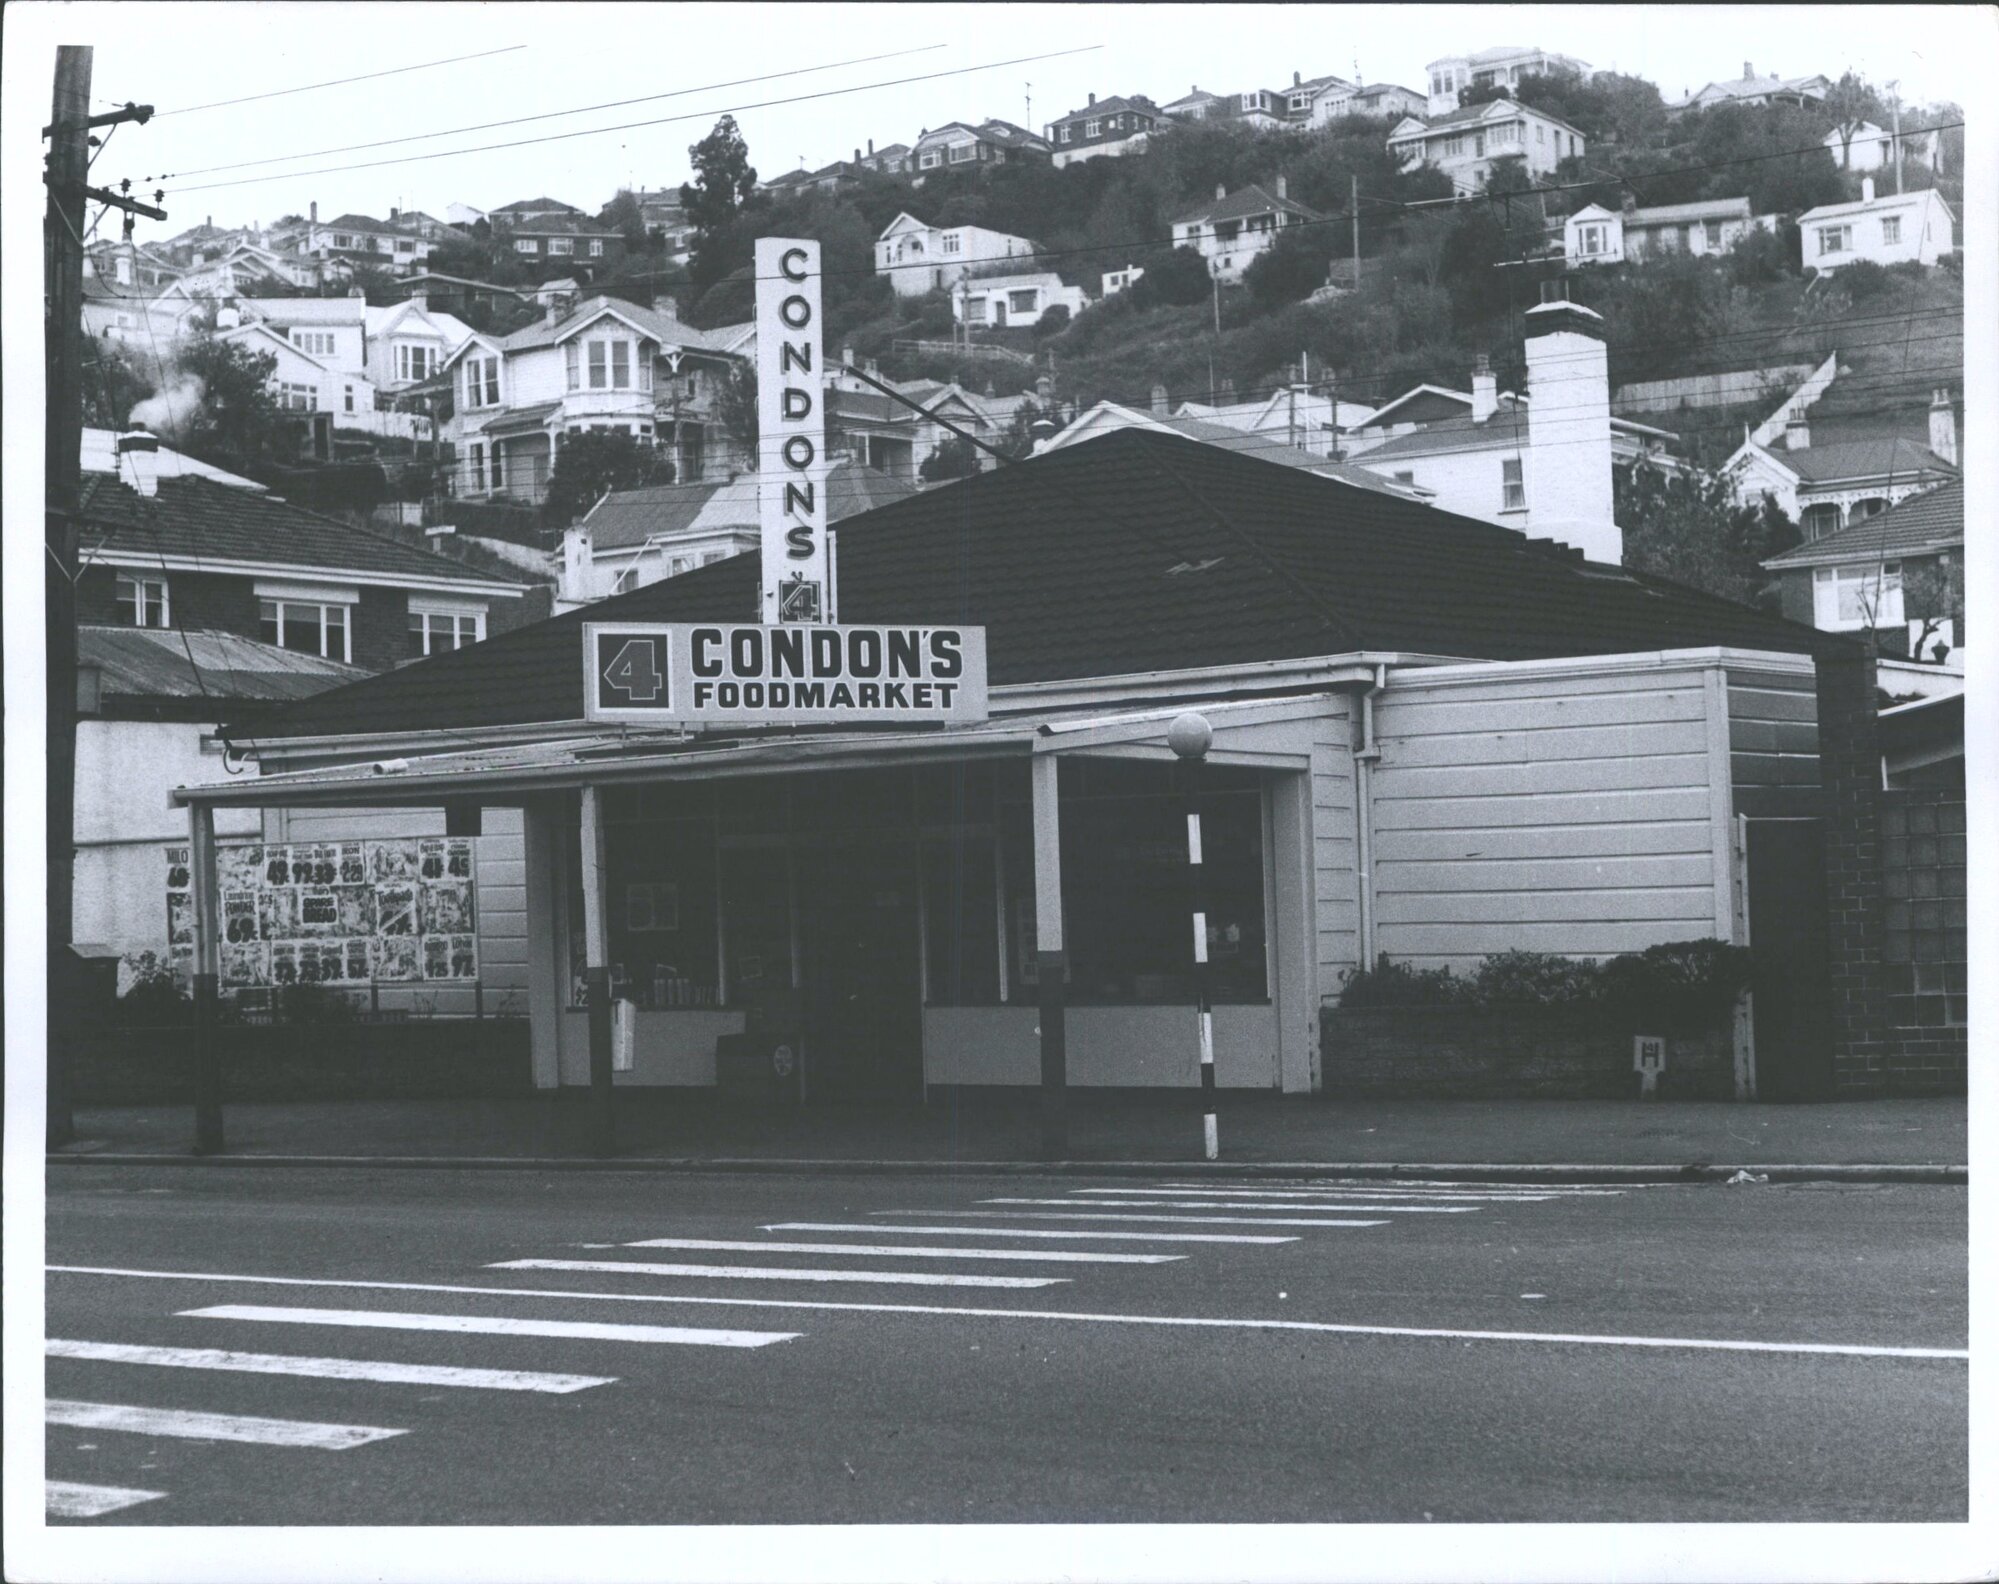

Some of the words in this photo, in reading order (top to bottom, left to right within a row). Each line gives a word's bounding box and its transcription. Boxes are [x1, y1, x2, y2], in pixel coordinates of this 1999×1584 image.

[780, 247, 816, 561] CONDONS
[783, 584, 818, 622] 4
[603, 639, 662, 700] 4
[690, 628, 963, 680] CONDON'S
[693, 682, 959, 710] FOODMARKET
[1641, 1042, 1660, 1068] H
